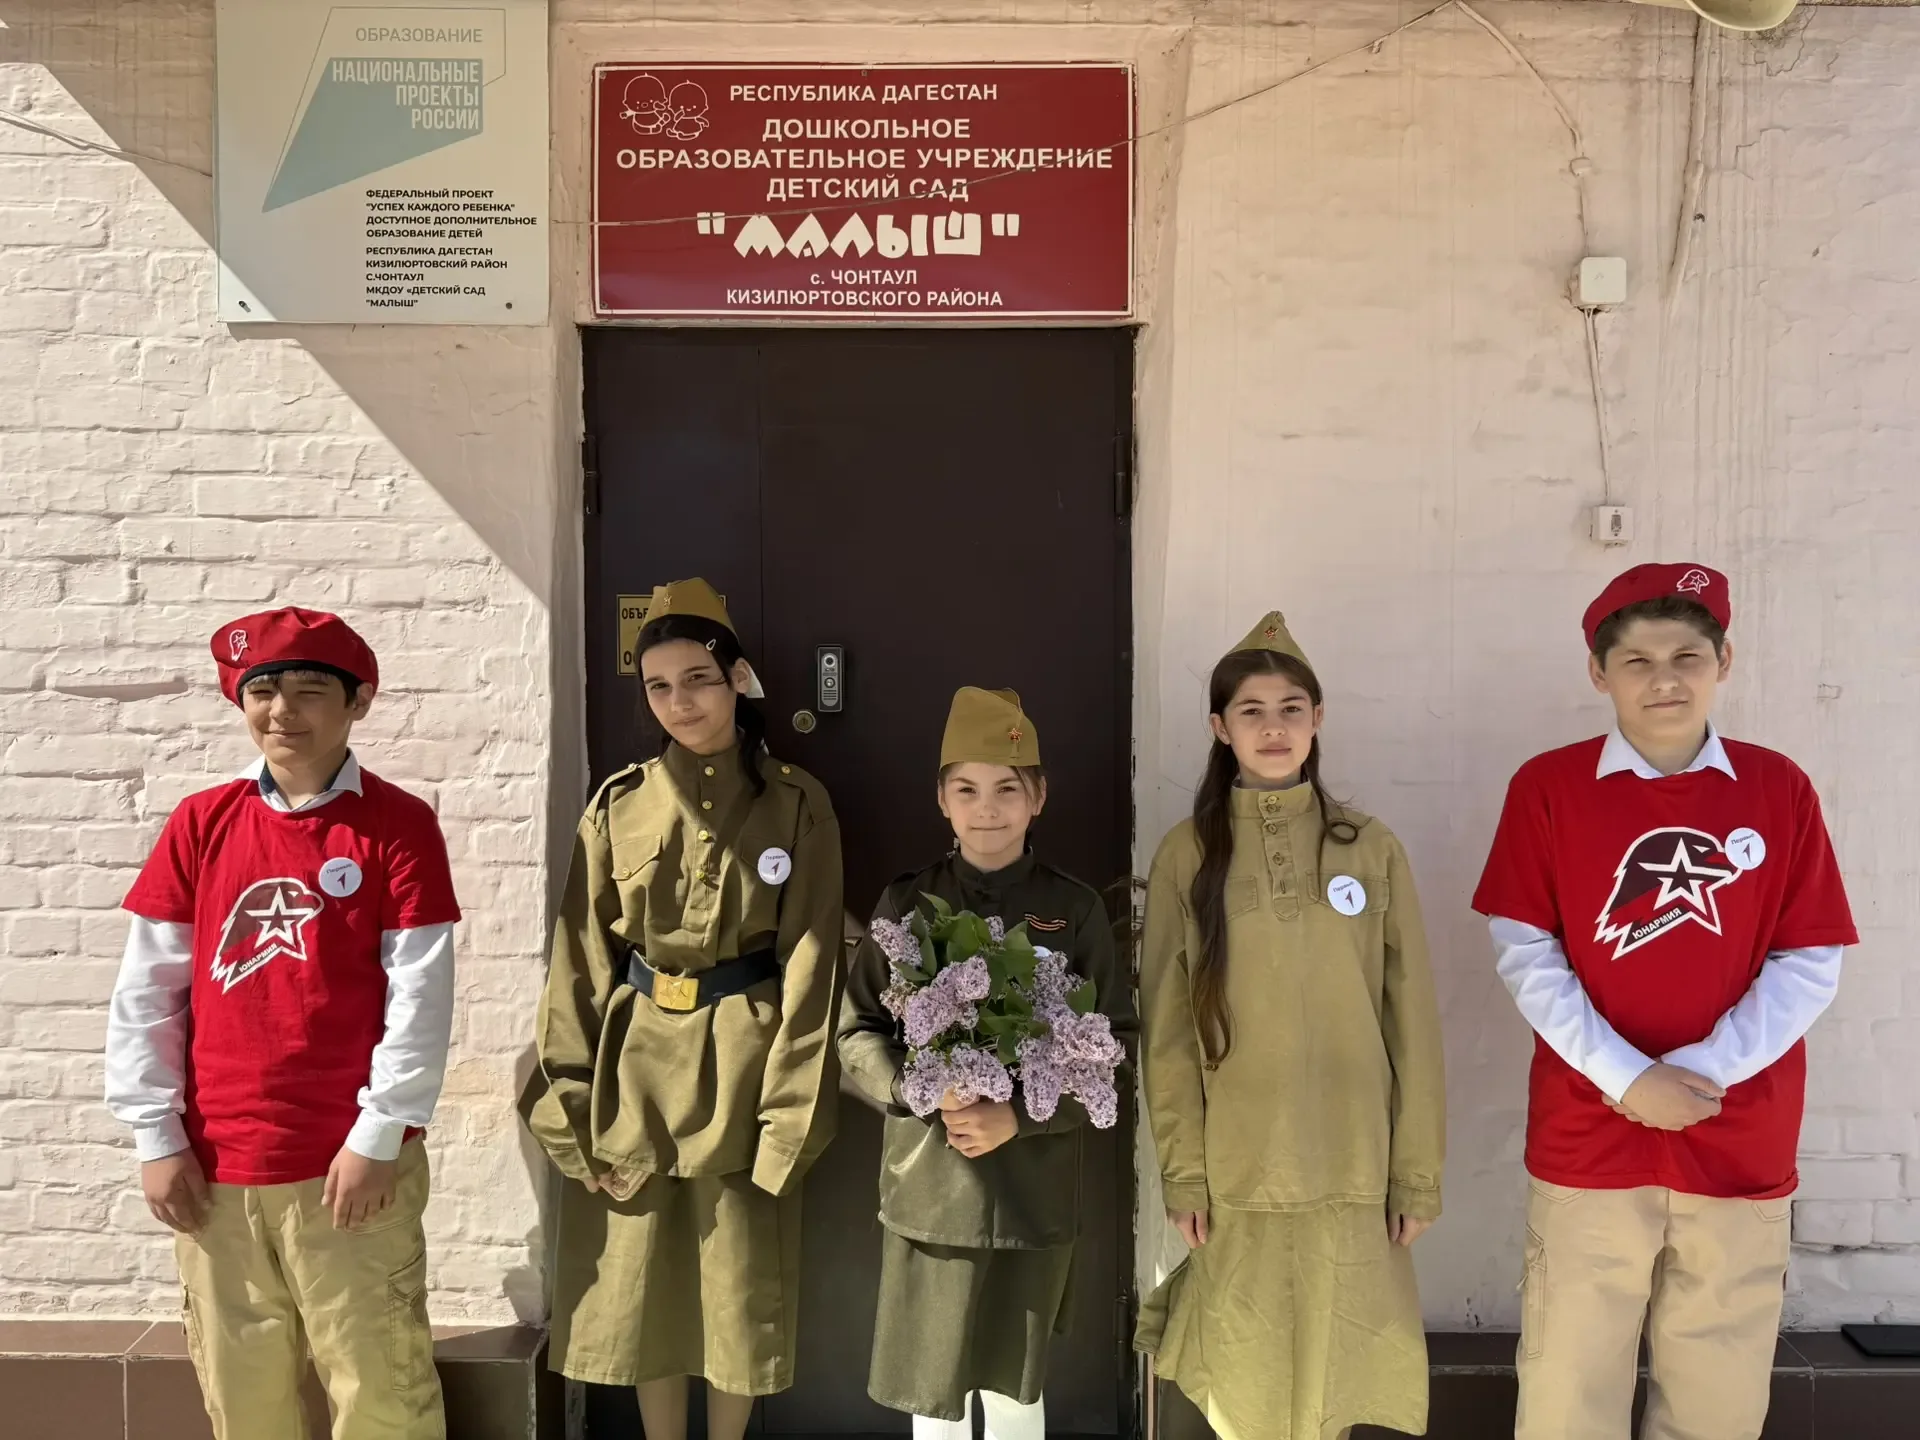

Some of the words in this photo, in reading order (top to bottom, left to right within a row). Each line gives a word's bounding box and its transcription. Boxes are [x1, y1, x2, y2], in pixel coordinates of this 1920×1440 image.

[355, 27, 483, 43] ОБРАЗОВАНИЕ
[332, 61, 479, 84] НАЦИОНАЛЬНЫЕ
[396, 85, 479, 106] ПРОЕКТЫ
[730, 84, 876, 103] РЕСПУБЛИКА
[882, 84, 998, 104] ДАГЕСТАН
[412, 109, 479, 130] РОССИИ
[763, 119, 971, 141] ДОШКОЛЬНОЕ
[617, 148, 906, 169] ОБРАЗОВАТЕЛЬНОЕ
[918, 148, 1113, 172] УЧРЕЖДЕНИЕ
[366, 188, 449, 199] ФЕДЕРАЛЬНЫЙ
[453, 190, 494, 199] ПРОЕКТ
[767, 174, 900, 202] ДЕТСКИЙ
[909, 178, 969, 202] САД
[366, 203, 405, 212] "УСПЕХ
[407, 203, 460, 212] КАЖДОГО
[463, 203, 515, 212] РЕБЕНКА"
[366, 216, 431, 226] ДОСТУПНОЕ
[433, 217, 537, 226] ДОПОЛНИТЕЛЬНОЕ
[366, 229, 446, 238] ОБРАЗОВАНИЕ
[448, 228, 483, 239] ДЕТЕЙ
[366, 247, 436, 256] РЕСПУБЛИКА
[438, 247, 493, 257] ДАГЕСТАН
[366, 258, 468, 269] КИЗИЛЮРТОВСКИЙ
[470, 258, 507, 269] РАЙОН
[366, 273, 424, 282] С.ЧОНТАУЛ
[810, 273, 824, 285] с.
[831, 269, 918, 285] ЧОНТАУЛ
[366, 286, 403, 295] МКДОУ
[406, 285, 461, 295] «ДЕТСКИЙ
[464, 286, 485, 295] САД
[727, 288, 922, 306] КИЗИЛЮРТОВСКОГО
[927, 287, 1002, 306] РАЙОНА
[366, 299, 418, 308] "МАЛЫШ"
[1632, 907, 1682, 940] ЮНАРМИЯ
[238, 943, 277, 973] ЮНАРМИЯ
